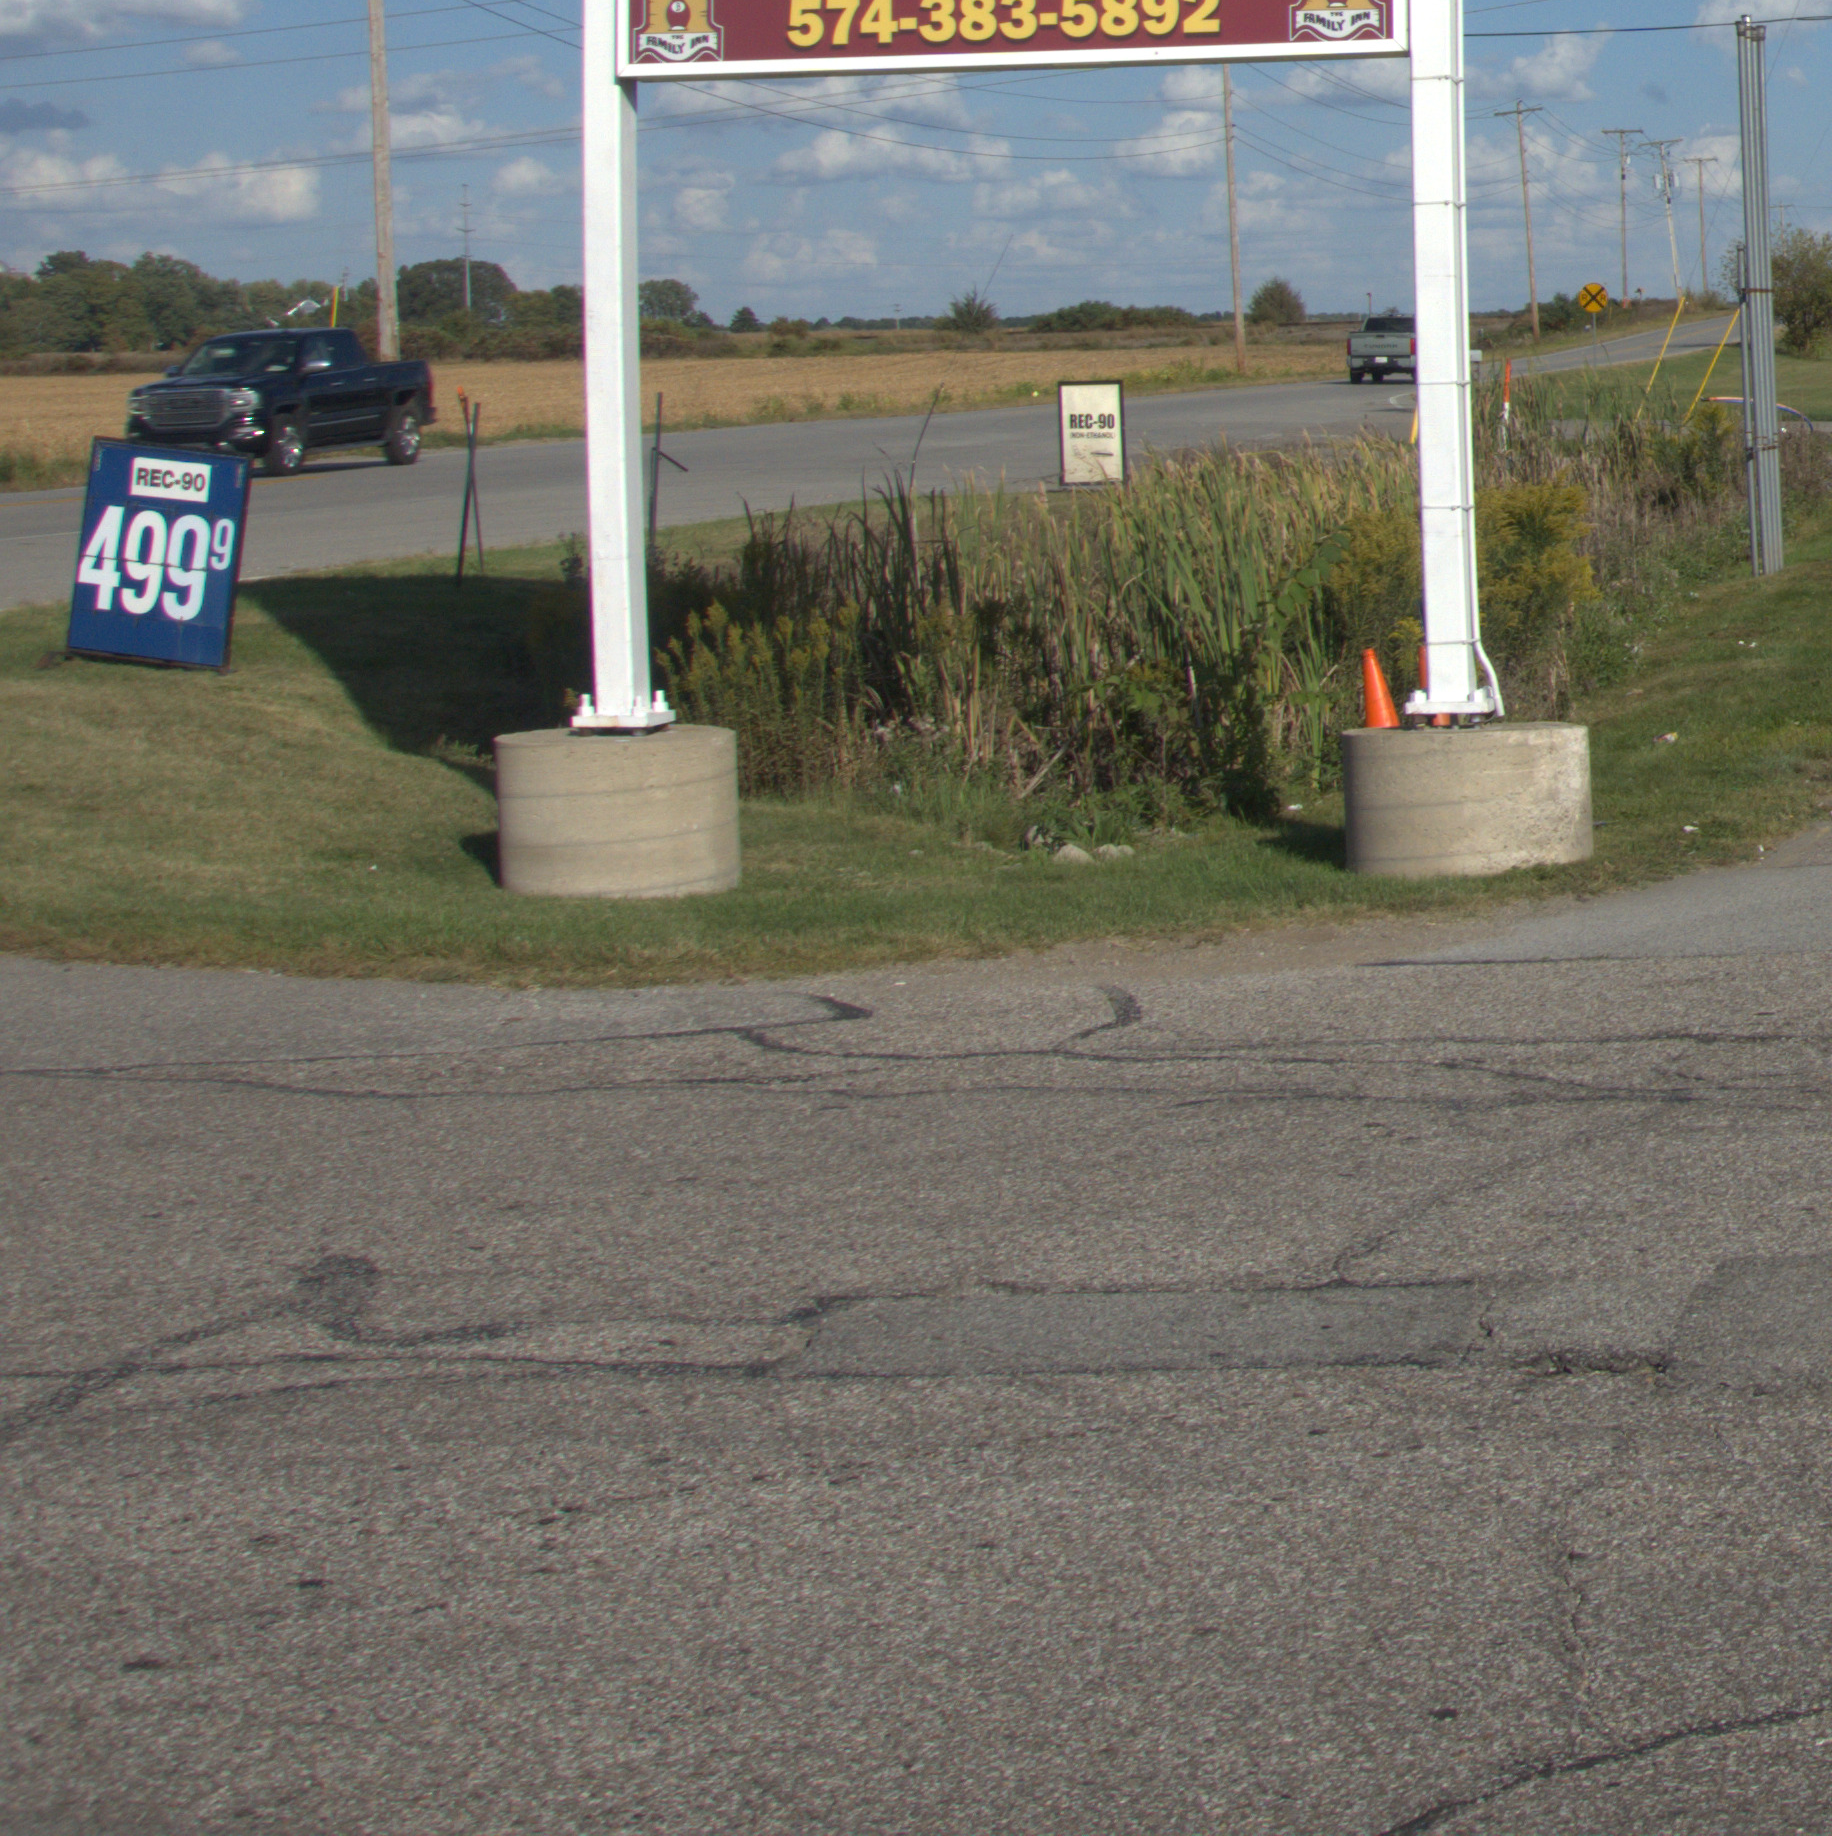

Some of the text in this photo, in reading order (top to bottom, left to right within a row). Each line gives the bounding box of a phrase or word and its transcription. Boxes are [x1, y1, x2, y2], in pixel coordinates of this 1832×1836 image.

[1304, 11, 1370, 32] FAMILY INN
[646, 36, 685, 54] FAMILY
[1070, 413, 1116, 429] REC-90
[135, 466, 207, 493] REC-90
